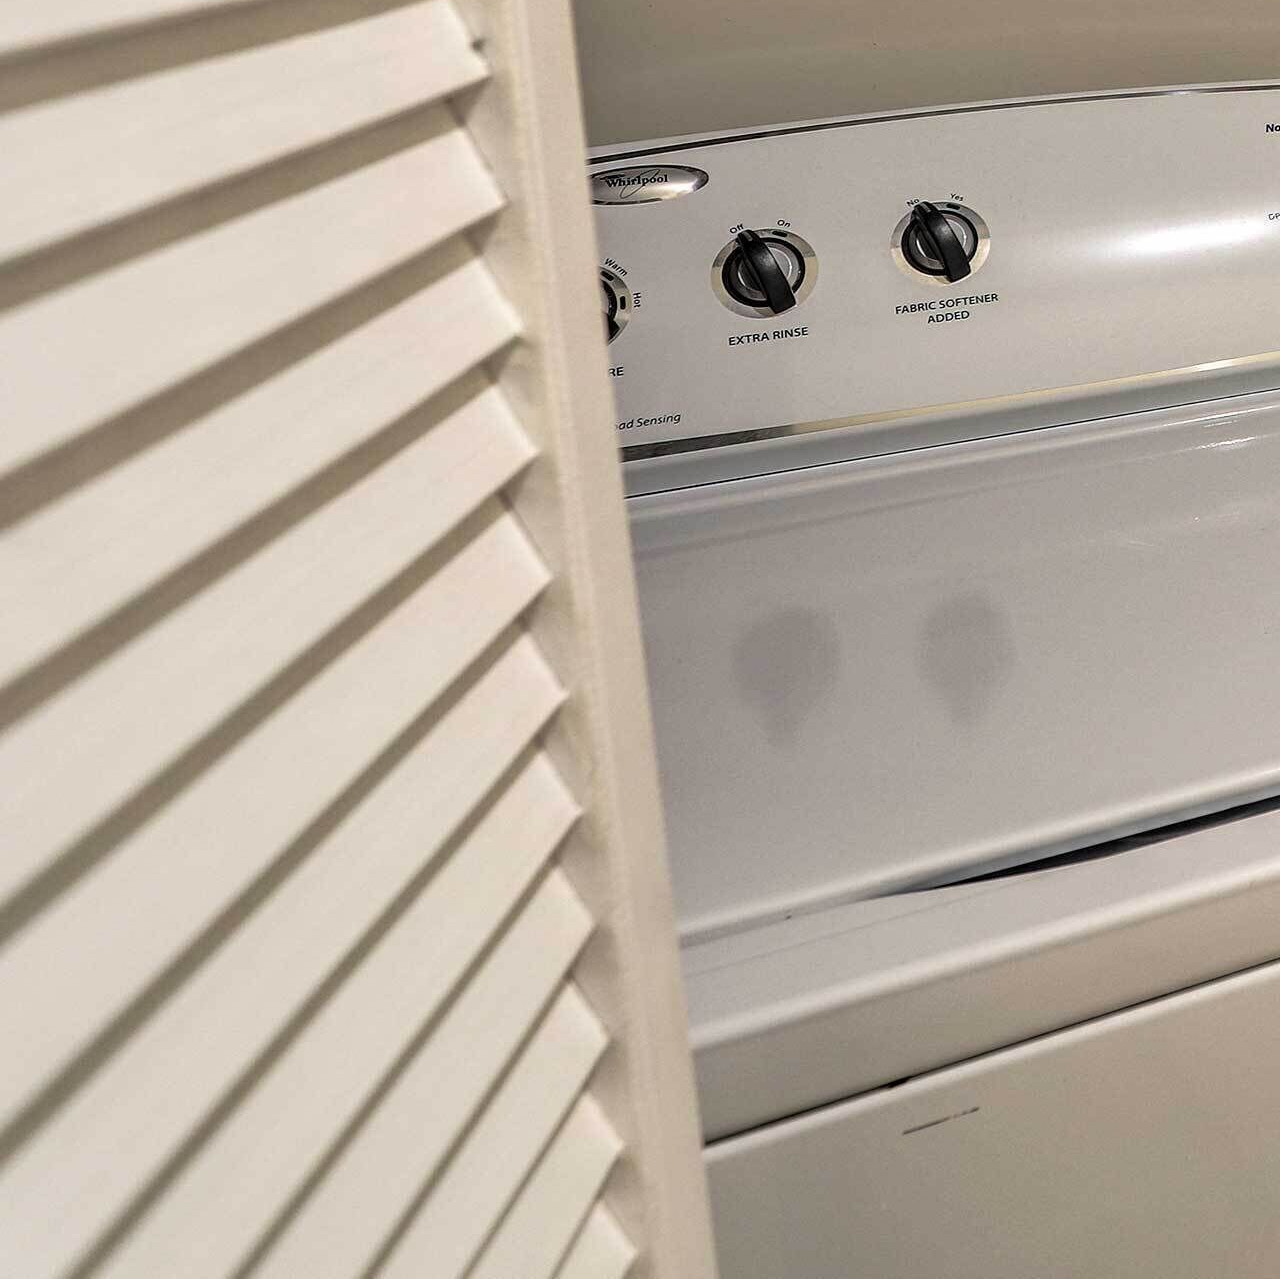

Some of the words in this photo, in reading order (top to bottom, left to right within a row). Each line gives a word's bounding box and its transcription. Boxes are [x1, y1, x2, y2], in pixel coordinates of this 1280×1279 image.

[606, 175, 668, 188] Whirlpool
[907, 198, 920, 207] No
[950, 193, 964, 202] Yes
[730, 224, 744, 234] Off
[777, 220, 791, 228] On
[604, 258, 628, 277] Warm
[632, 292, 642, 308] Hot
[896, 302, 936, 315] FABRIC
[938, 293, 999, 309] SOFTENER
[928, 310, 970, 324] ADDED
[728, 332, 770, 346] EXTRA
[772, 326, 809, 340] RINSE
[636, 413, 681, 428] Sensing
